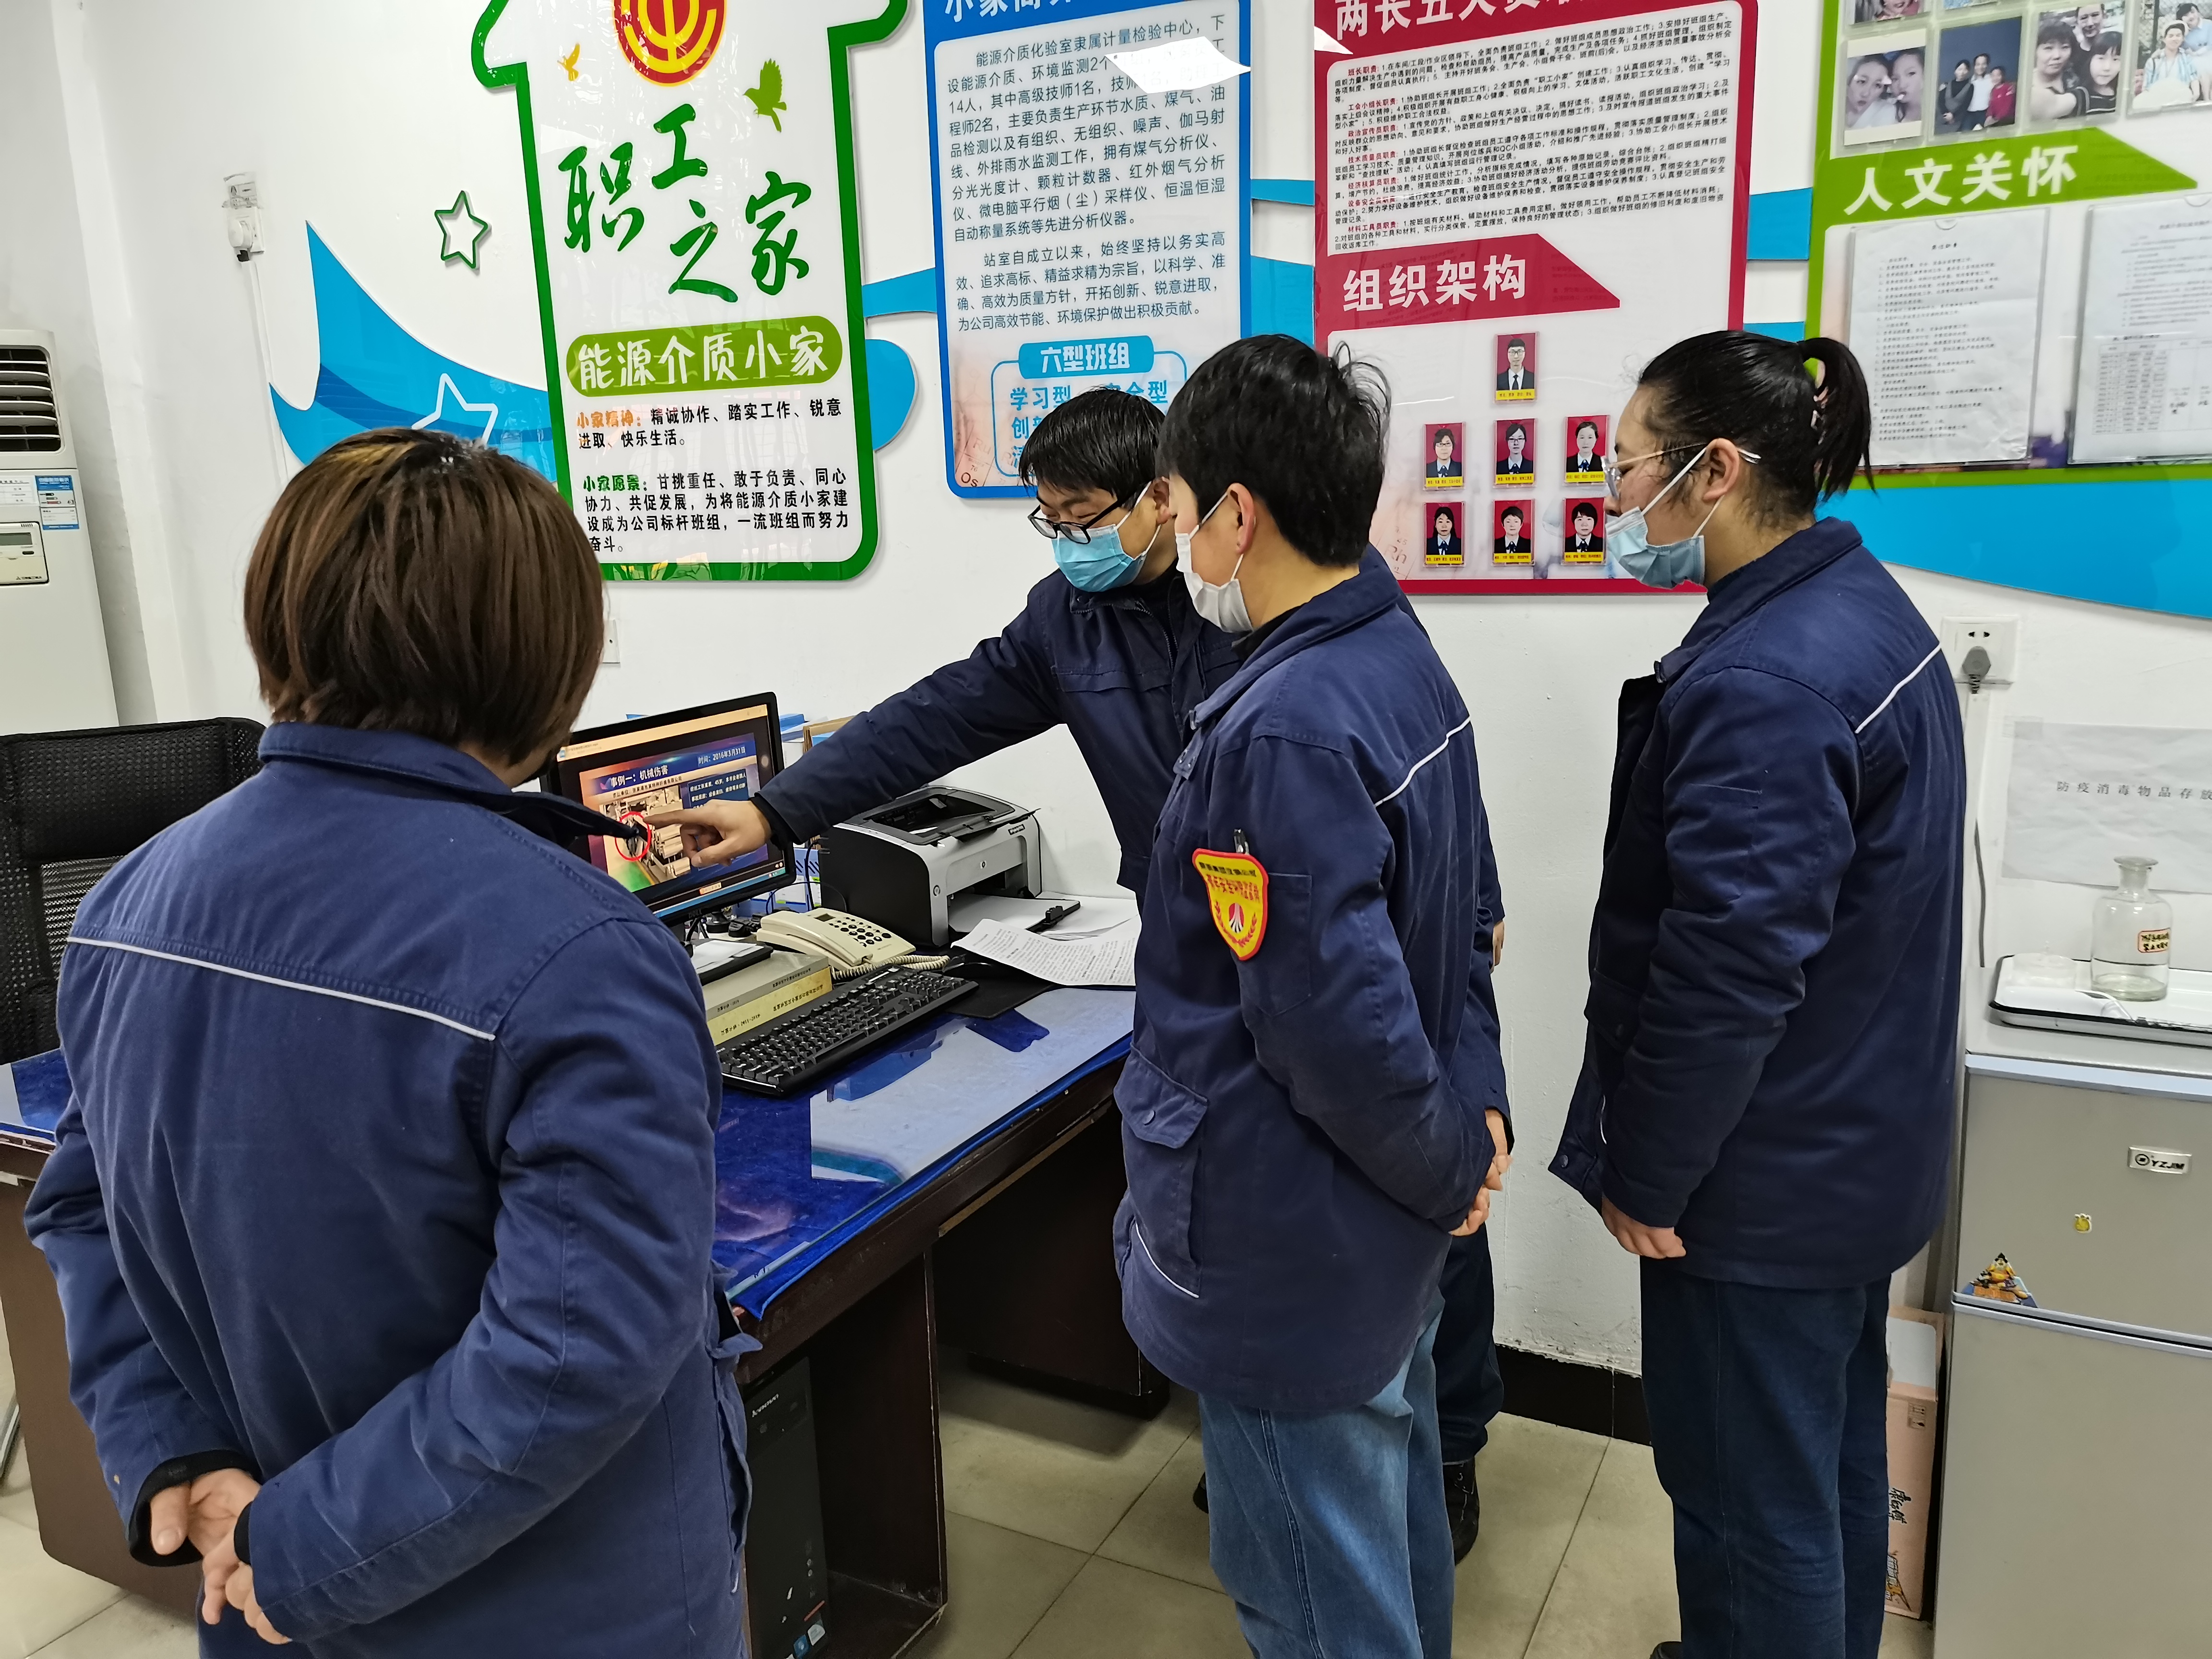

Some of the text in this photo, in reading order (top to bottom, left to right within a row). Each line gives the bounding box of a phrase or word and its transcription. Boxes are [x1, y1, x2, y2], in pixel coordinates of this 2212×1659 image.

[976, 14, 1225, 67] 能源介质化验室隶属计量检验中心，下
[951, 109, 1225, 157] 品检测以及有组织、无组织、噪声、伽马射
[951, 133, 1220, 179] 线、外排雨水监测工作，拥有煤气分析仪、
[953, 155, 1225, 200] 分光光度计、颗粒计数器、红外烟气分析
[1844, 145, 2078, 215] 人文关怀
[558, 104, 812, 303] 职工之家
[1335, 215, 1365, 225] 管理记录。
[954, 212, 1136, 242] 自动称量系统等先进分析仪器。
[1335, 239, 1379, 250] 回收返库工作。
[984, 231, 1225, 267] 站室自成立以来，始终坚持以务实高
[956, 253, 1225, 291] 效、追求高标、精益求精为宗旨，以科学、准
[1342, 253, 1526, 312] 组织架构
[958, 276, 1218, 312] 确、高效为质量方针，开拓创新、锐意进取，
[959, 301, 1200, 331] 为公司高效节能、环境保护做出积极贡献。
[577, 325, 828, 391] 能源介质小家
[1041, 342, 1130, 373] 六型班组
[578, 429, 686, 450] 进取、快乐生活。
[961, 472, 978, 487] Os
[585, 489, 848, 513] 协力、共促发展，为将能源介质小家建
[588, 511, 849, 532] 设成为公司标杆班组，一流班组而努力
